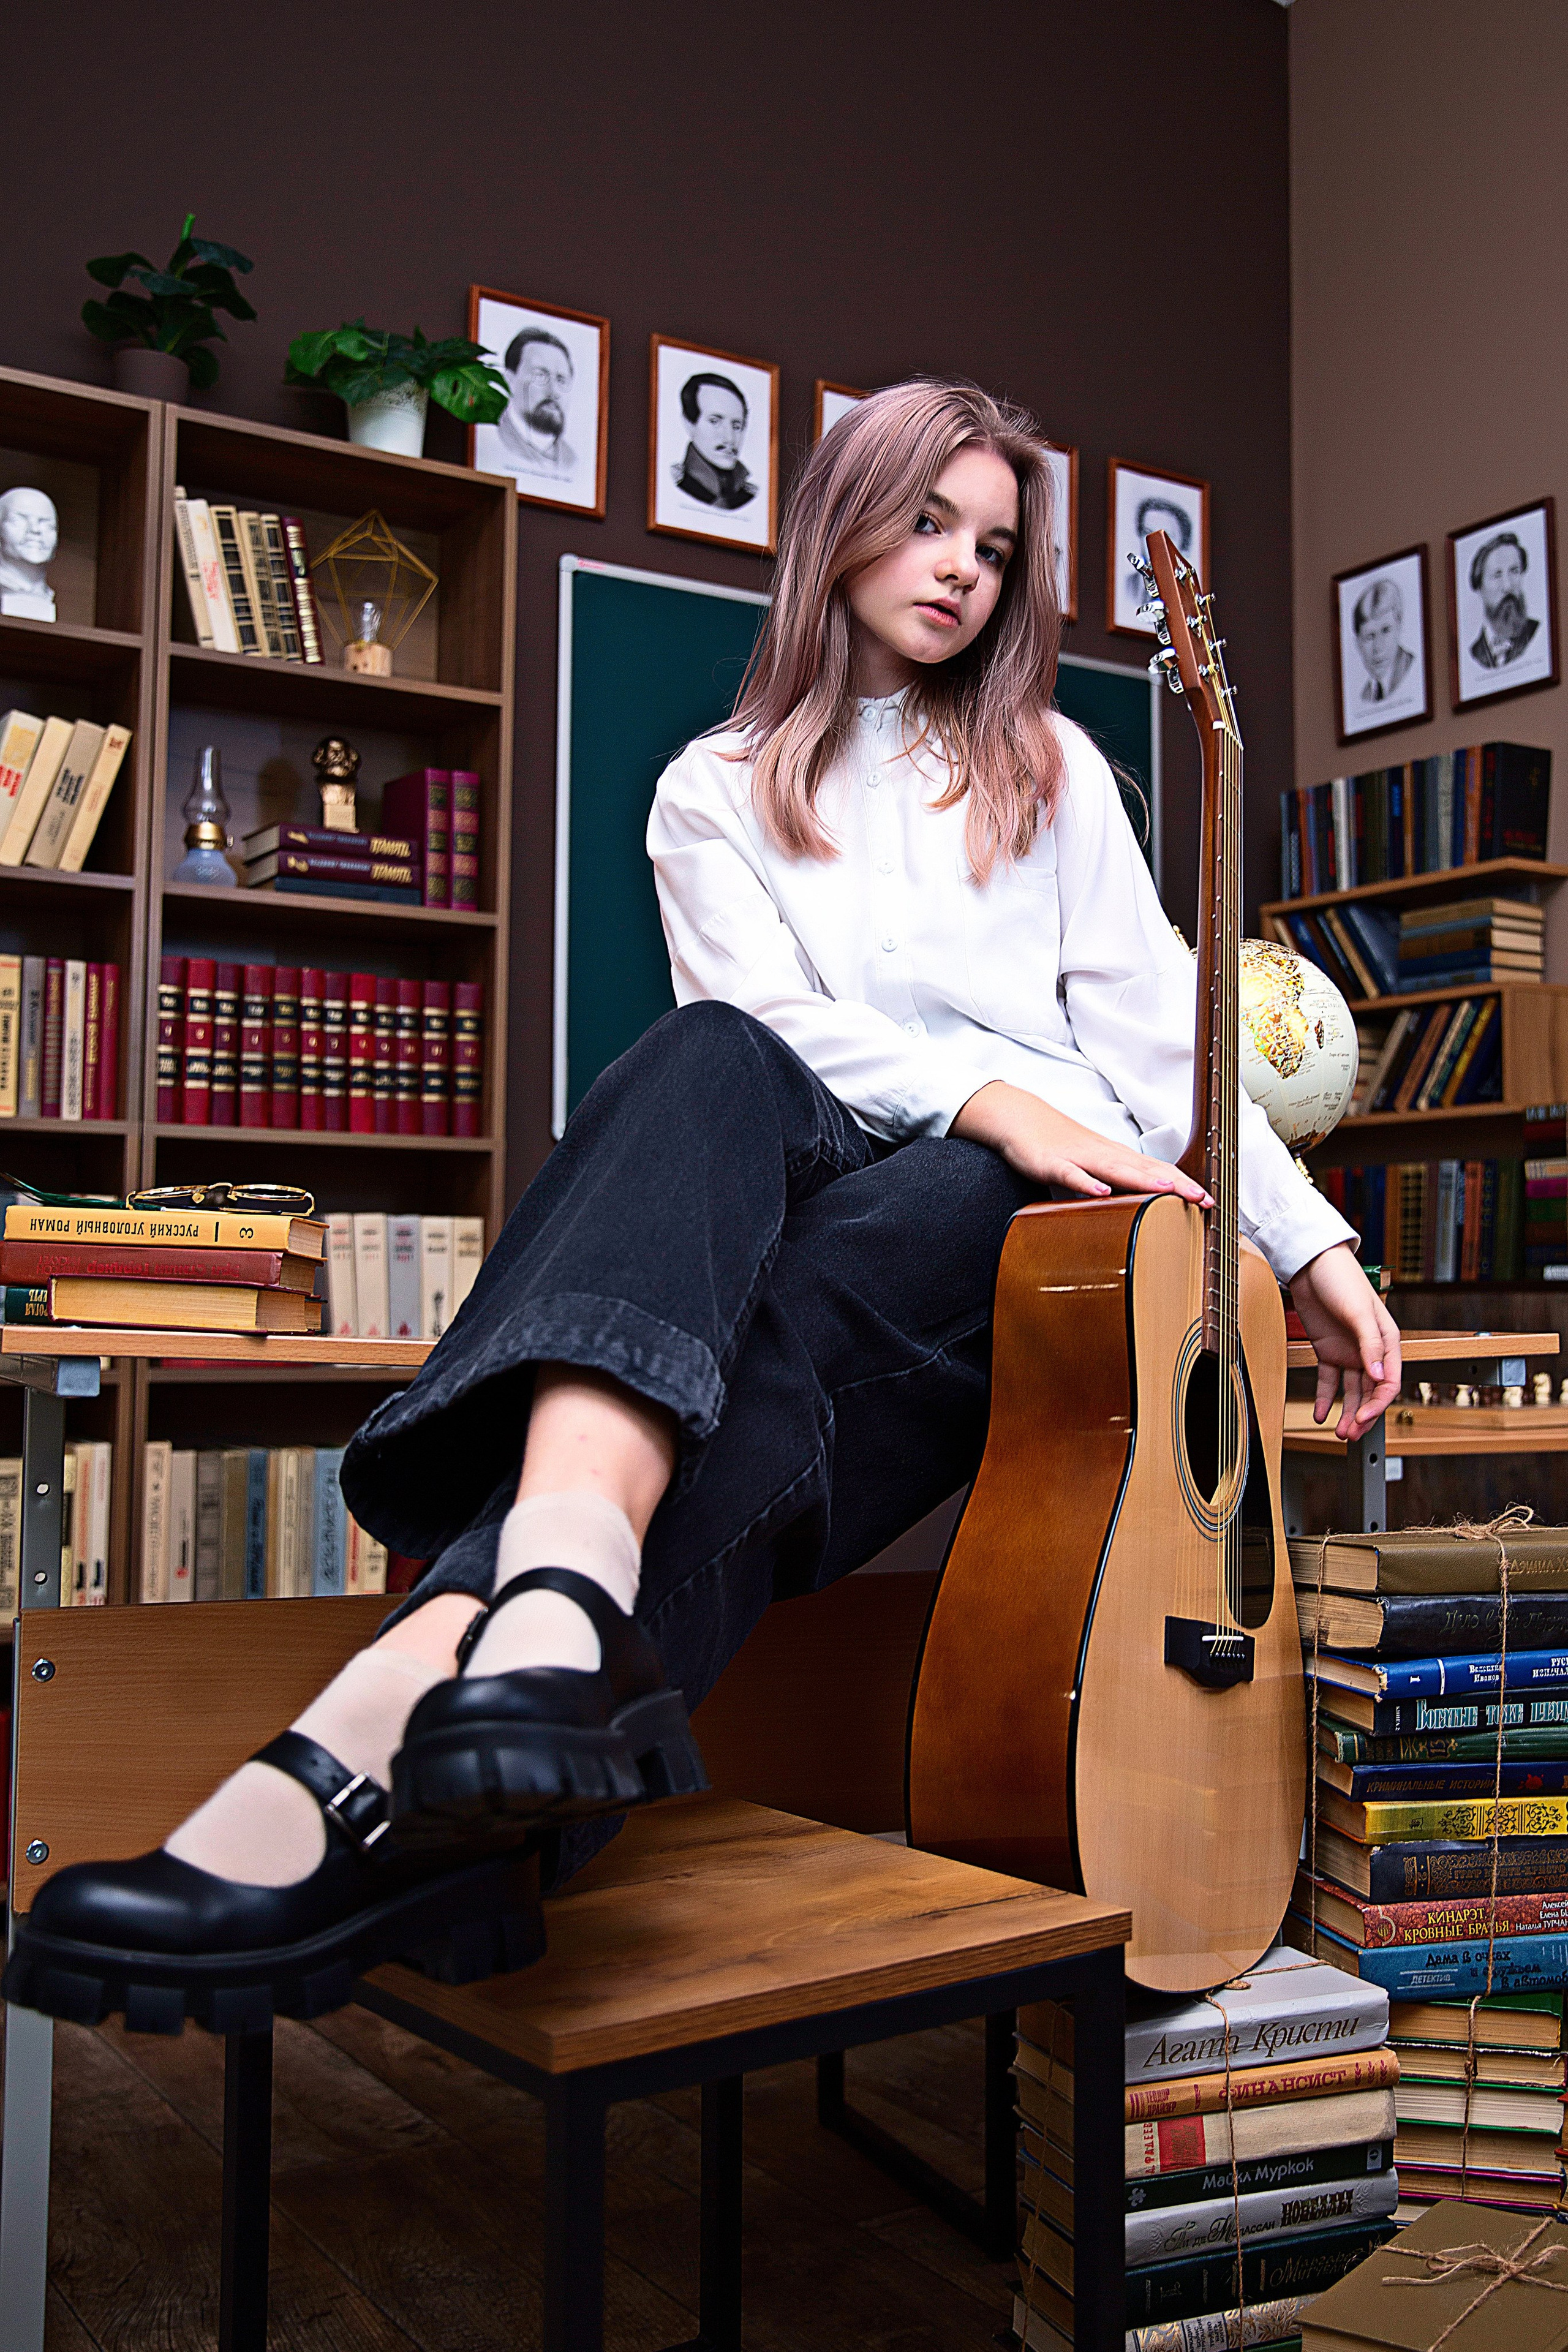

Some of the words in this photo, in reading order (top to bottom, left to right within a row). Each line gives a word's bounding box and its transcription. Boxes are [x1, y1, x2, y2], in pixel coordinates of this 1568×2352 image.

[30, 1218, 70, 1232] РОМАН
[77, 1219, 145, 1236] УГОЛОВНЫЙ
[149, 1223, 199, 1238] РУССКИЙ
[29, 1289, 48, 1302] ЕРТЬ
[24, 1303, 48, 1316] РОГАЯ
[1474, 1673, 1499, 1683] Иванов
[1366, 1779, 1446, 1793] КРИМИНАЛЬНЫЕ
[1449, 1778, 1495, 1790] ИСТОРИИ
[1539, 1910, 1559, 1919] Елена
[1404, 1924, 1463, 1943] КРОВНЫЕ
[1515, 1922, 1542, 1931] Наталья
[1426, 1953, 1460, 1968] Дама
[1411, 1973, 1451, 1986] ДЕТЕКТИВ
[1250, 2016, 1360, 2057] Кристи
[1218, 2069, 1348, 2101] ФИНАНСИСТ
[1145, 2089, 1170, 2103] ТЕОДОР
[1145, 2101, 1177, 2117] ДРАЙЗЕР
[1144, 2122, 1155, 2164] ФАДЕЕВ
[1202, 2170, 1251, 2191] Майкл
[1255, 2157, 1314, 2185] Муркок
